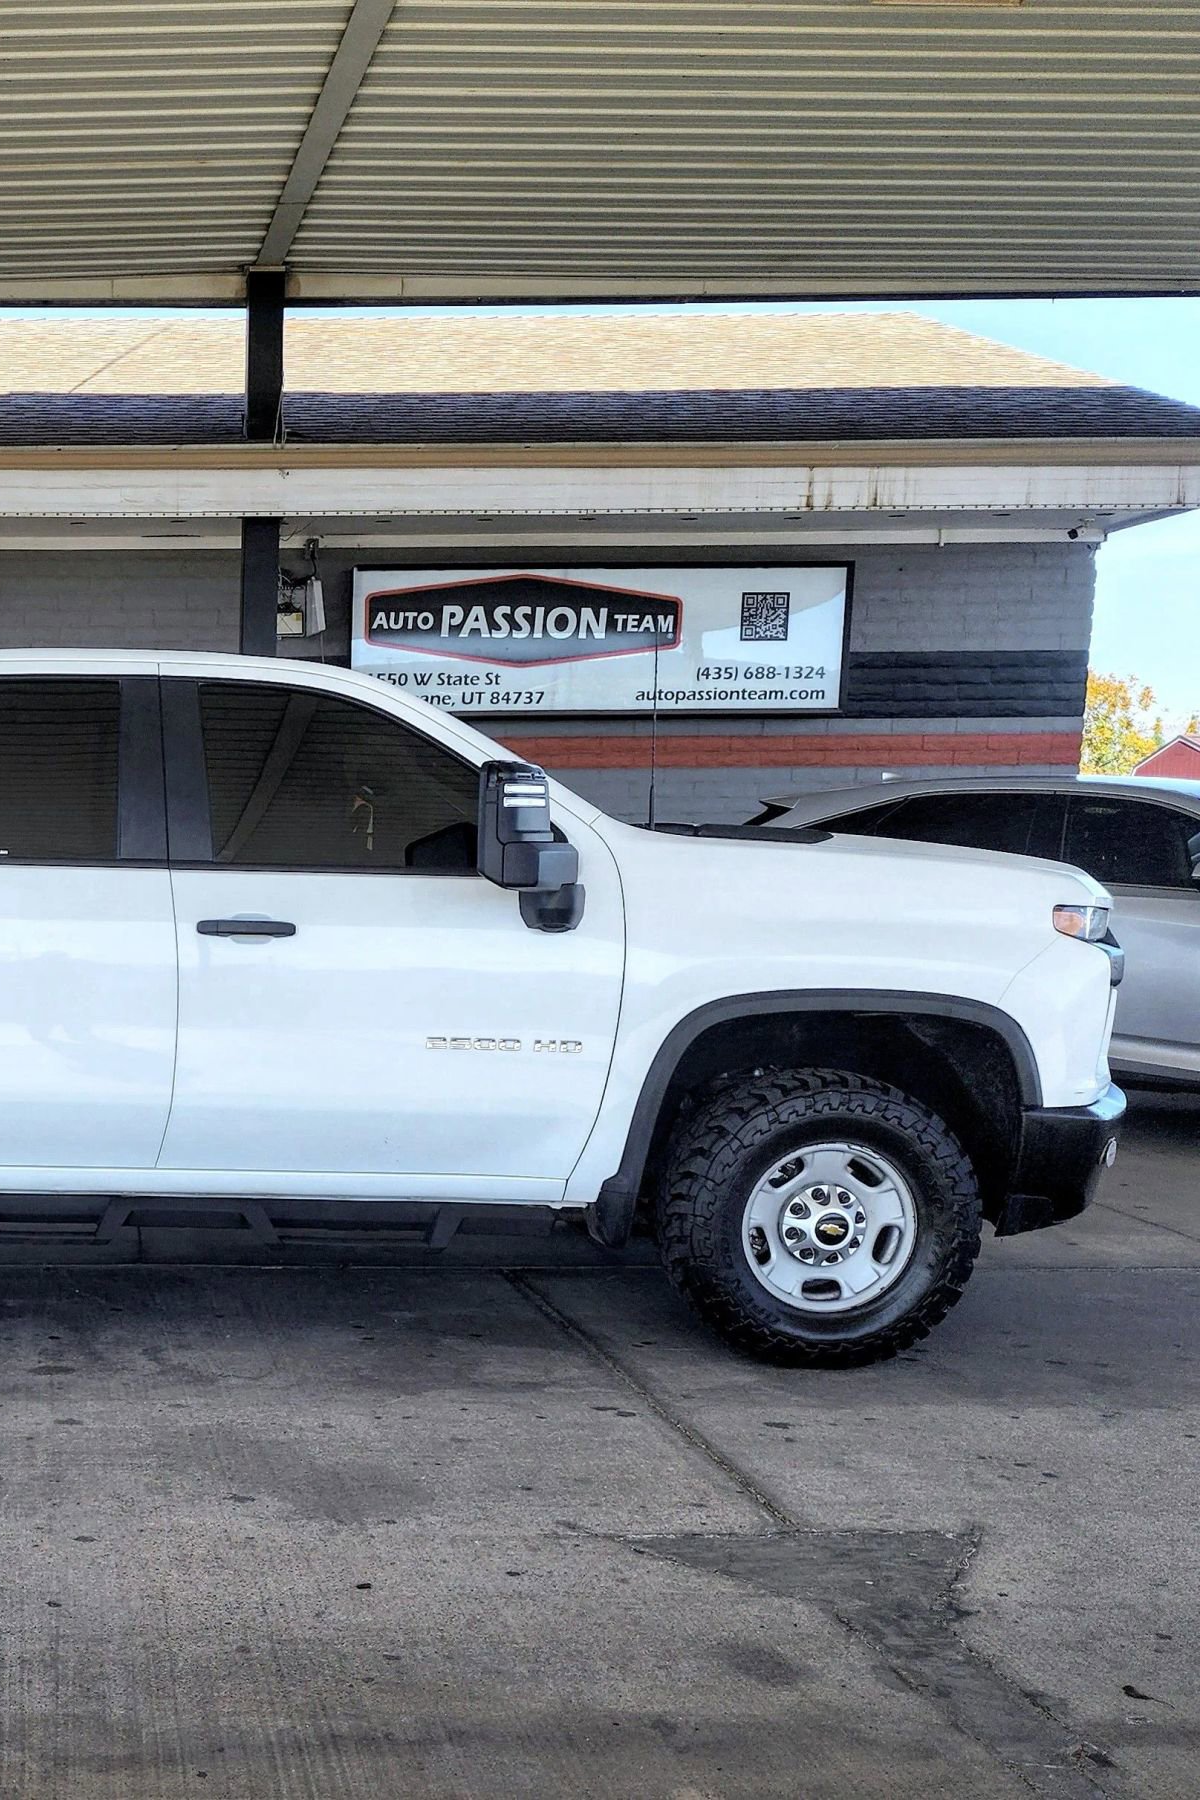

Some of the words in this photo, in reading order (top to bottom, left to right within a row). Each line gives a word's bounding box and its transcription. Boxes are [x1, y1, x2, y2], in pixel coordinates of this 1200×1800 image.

[371, 611, 434, 630] AUTO
[440, 605, 608, 639] PASSION
[614, 614, 674, 633] TEAM
[370, 672, 409, 687] 550
[413, 673, 433, 686] W
[436, 672, 481, 686] State
[484, 672, 501, 686] St
[696, 666, 739, 682] (435)
[743, 666, 827, 680] 688-1324
[461, 691, 486, 705] UT
[490, 691, 545, 705] 84737
[635, 687, 826, 704] autopassionteam.com
[425, 1036, 521, 1051] 2500
[533, 1040, 583, 1053] HD
